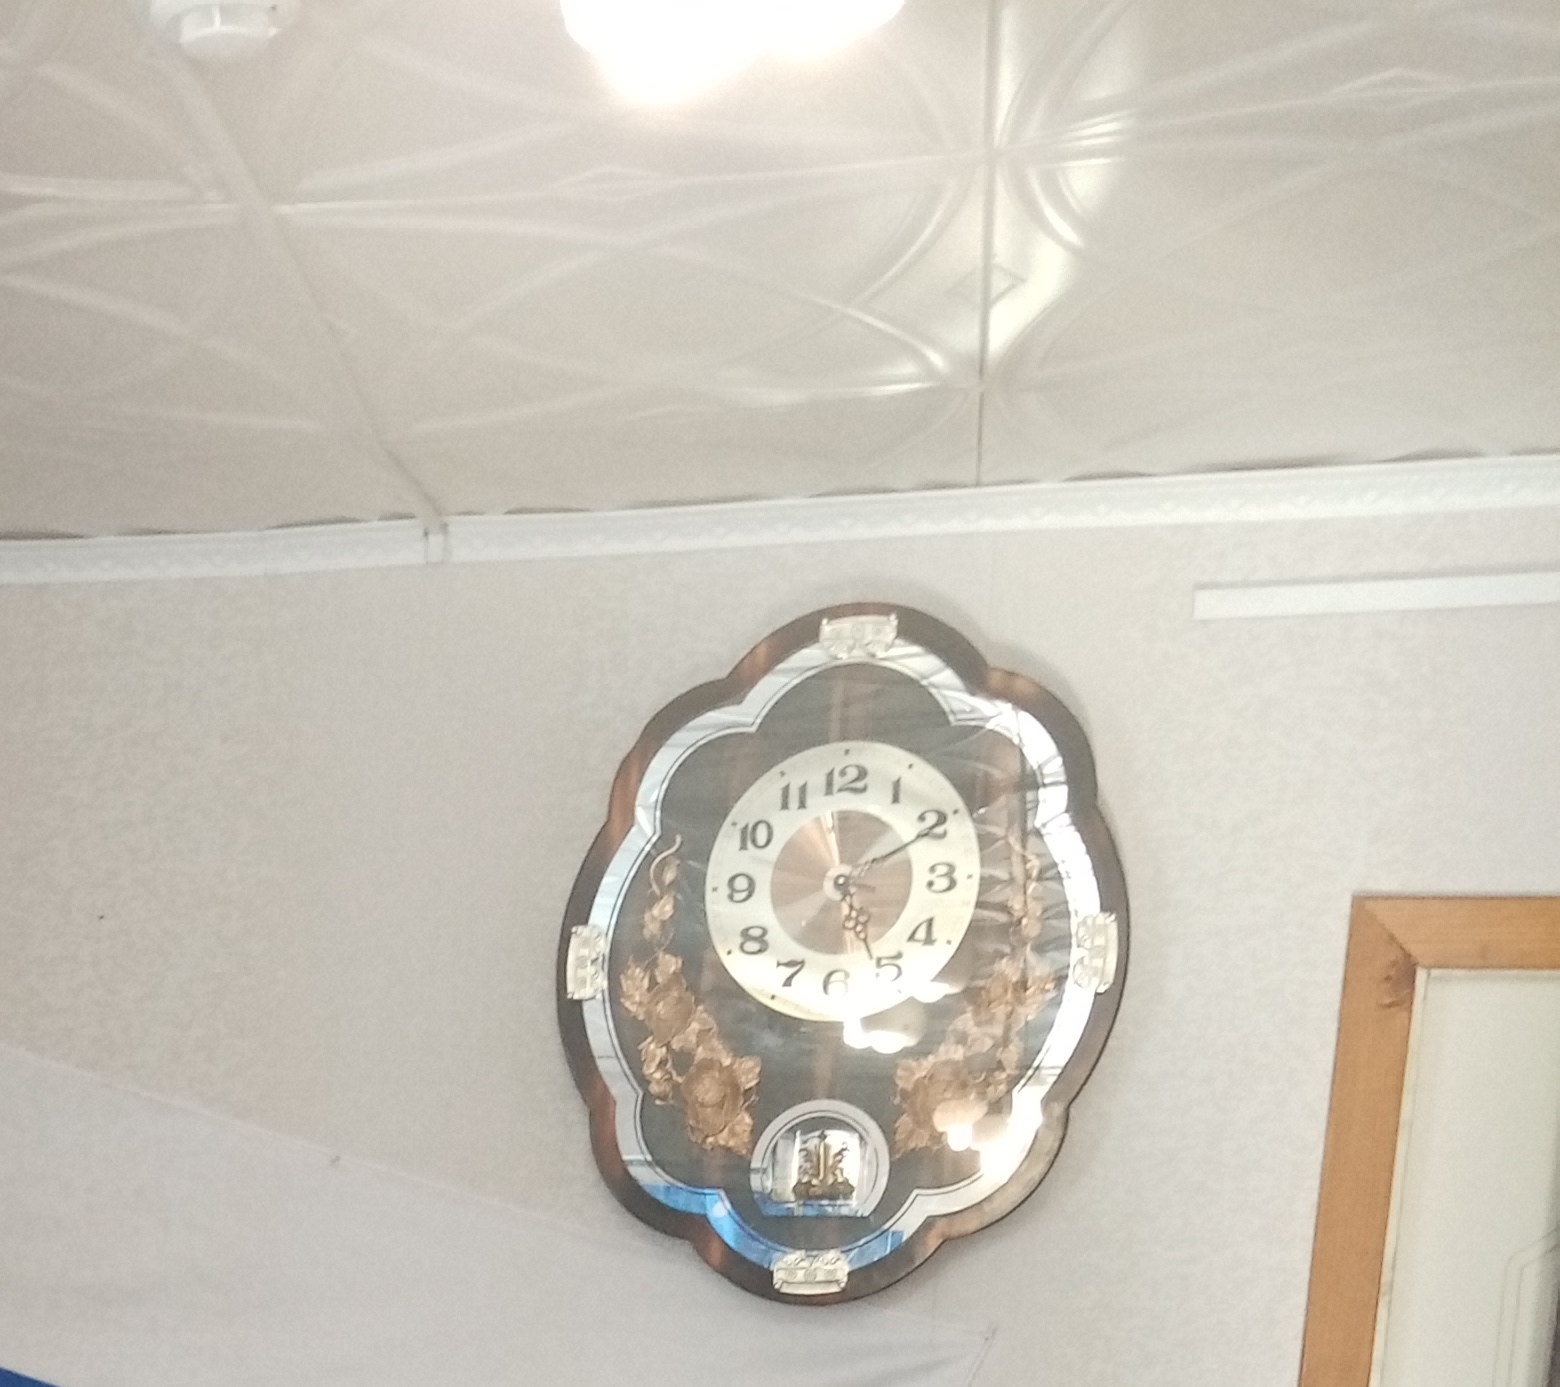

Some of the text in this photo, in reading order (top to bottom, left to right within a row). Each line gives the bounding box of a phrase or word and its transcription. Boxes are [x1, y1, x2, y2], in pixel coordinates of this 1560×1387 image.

[823, 764, 868, 796] 12
[891, 777, 901, 804] 1
[779, 781, 808, 811] 11
[739, 819, 773, 851] 10
[917, 809, 948, 840] 2
[726, 873, 755, 903] 9
[926, 862, 957, 893] 3
[739, 926, 769, 955] 8
[906, 917, 938, 946] 4
[776, 959, 805, 987] 7
[875, 951, 904, 982] 5
[822, 969, 850, 998] 6
